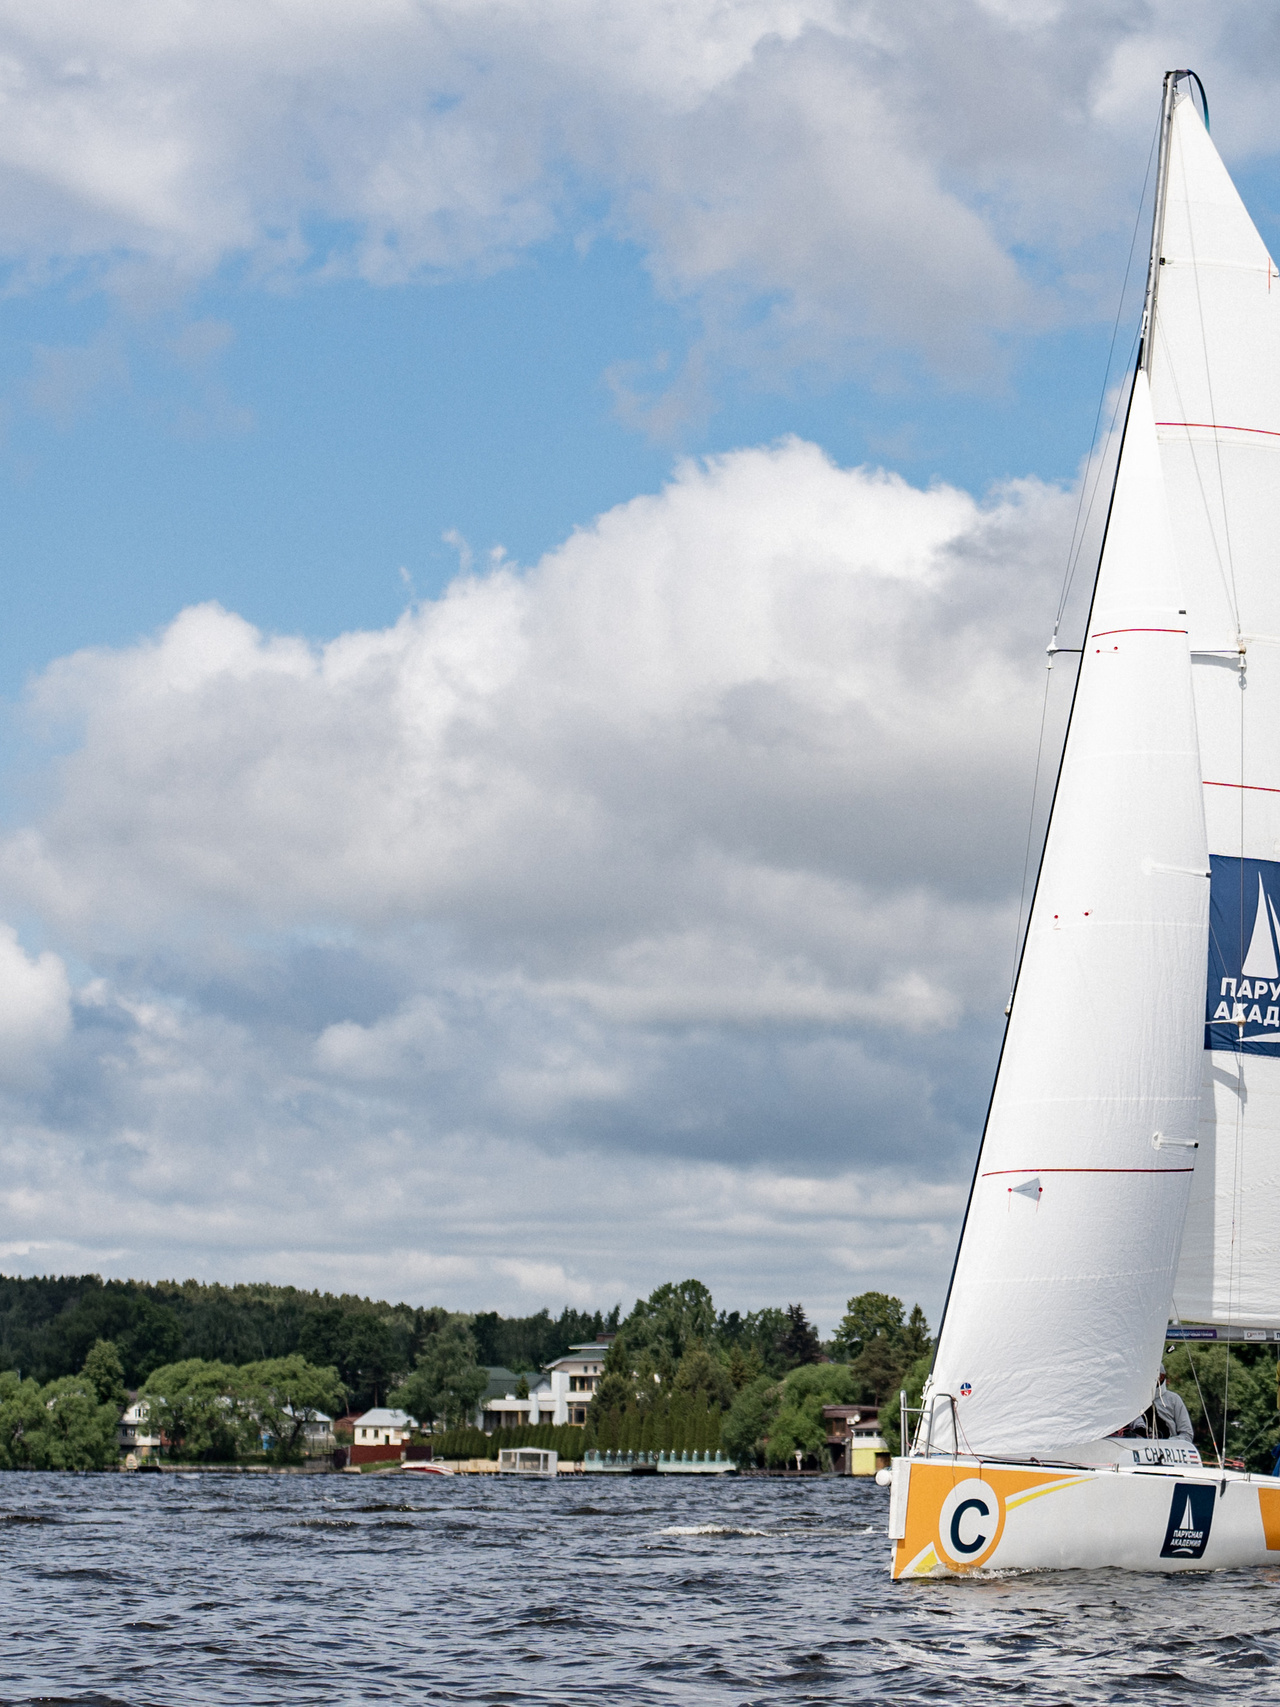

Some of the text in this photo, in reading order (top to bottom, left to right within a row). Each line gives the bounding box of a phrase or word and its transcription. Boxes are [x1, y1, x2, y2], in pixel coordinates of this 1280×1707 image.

[1144, 1447, 1188, 1464] CHARLIE
[950, 1498, 990, 1554] C
[1173, 1529, 1204, 1539] ПАРУСНАЯ
[1170, 1538, 1202, 1548] АКАДЕМИЯ
